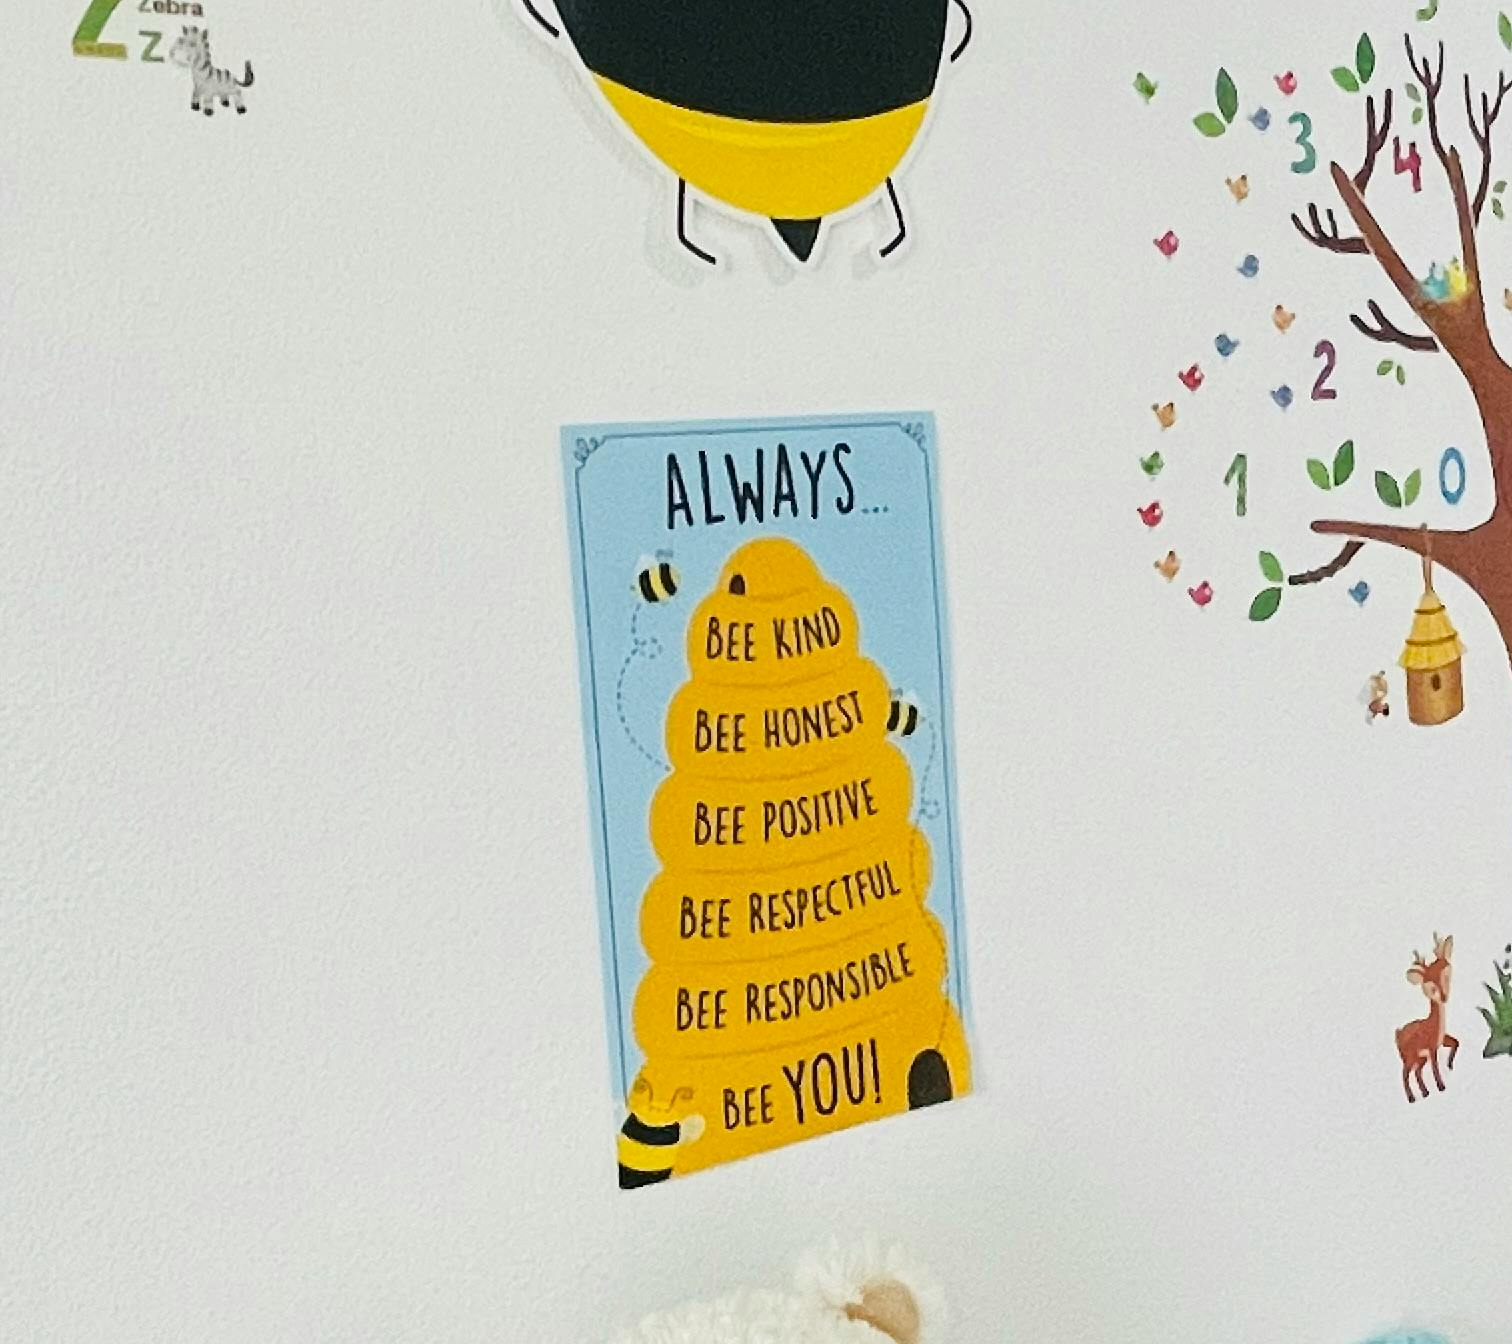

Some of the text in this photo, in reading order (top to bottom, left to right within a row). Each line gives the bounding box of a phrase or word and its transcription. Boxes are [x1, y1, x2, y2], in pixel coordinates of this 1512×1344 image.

[1287, 111, 1317, 174] 3
[1392, 136, 1422, 193] 4
[1311, 339, 1338, 401] 2
[666, 442, 889, 530] ALWAYS...
[1223, 452, 1248, 517] 1
[1439, 446, 1466, 506] 0
[705, 606, 842, 662] BEE KIND
[694, 690, 865, 753] BEE HONEST
[693, 777, 879, 846] BEE POSITIVE
[679, 860, 902, 941] BEE RESPECTFUL
[675, 942, 915, 1032] BEE RESPONSIBLE
[722, 1038, 882, 1131] BEE YOU!
